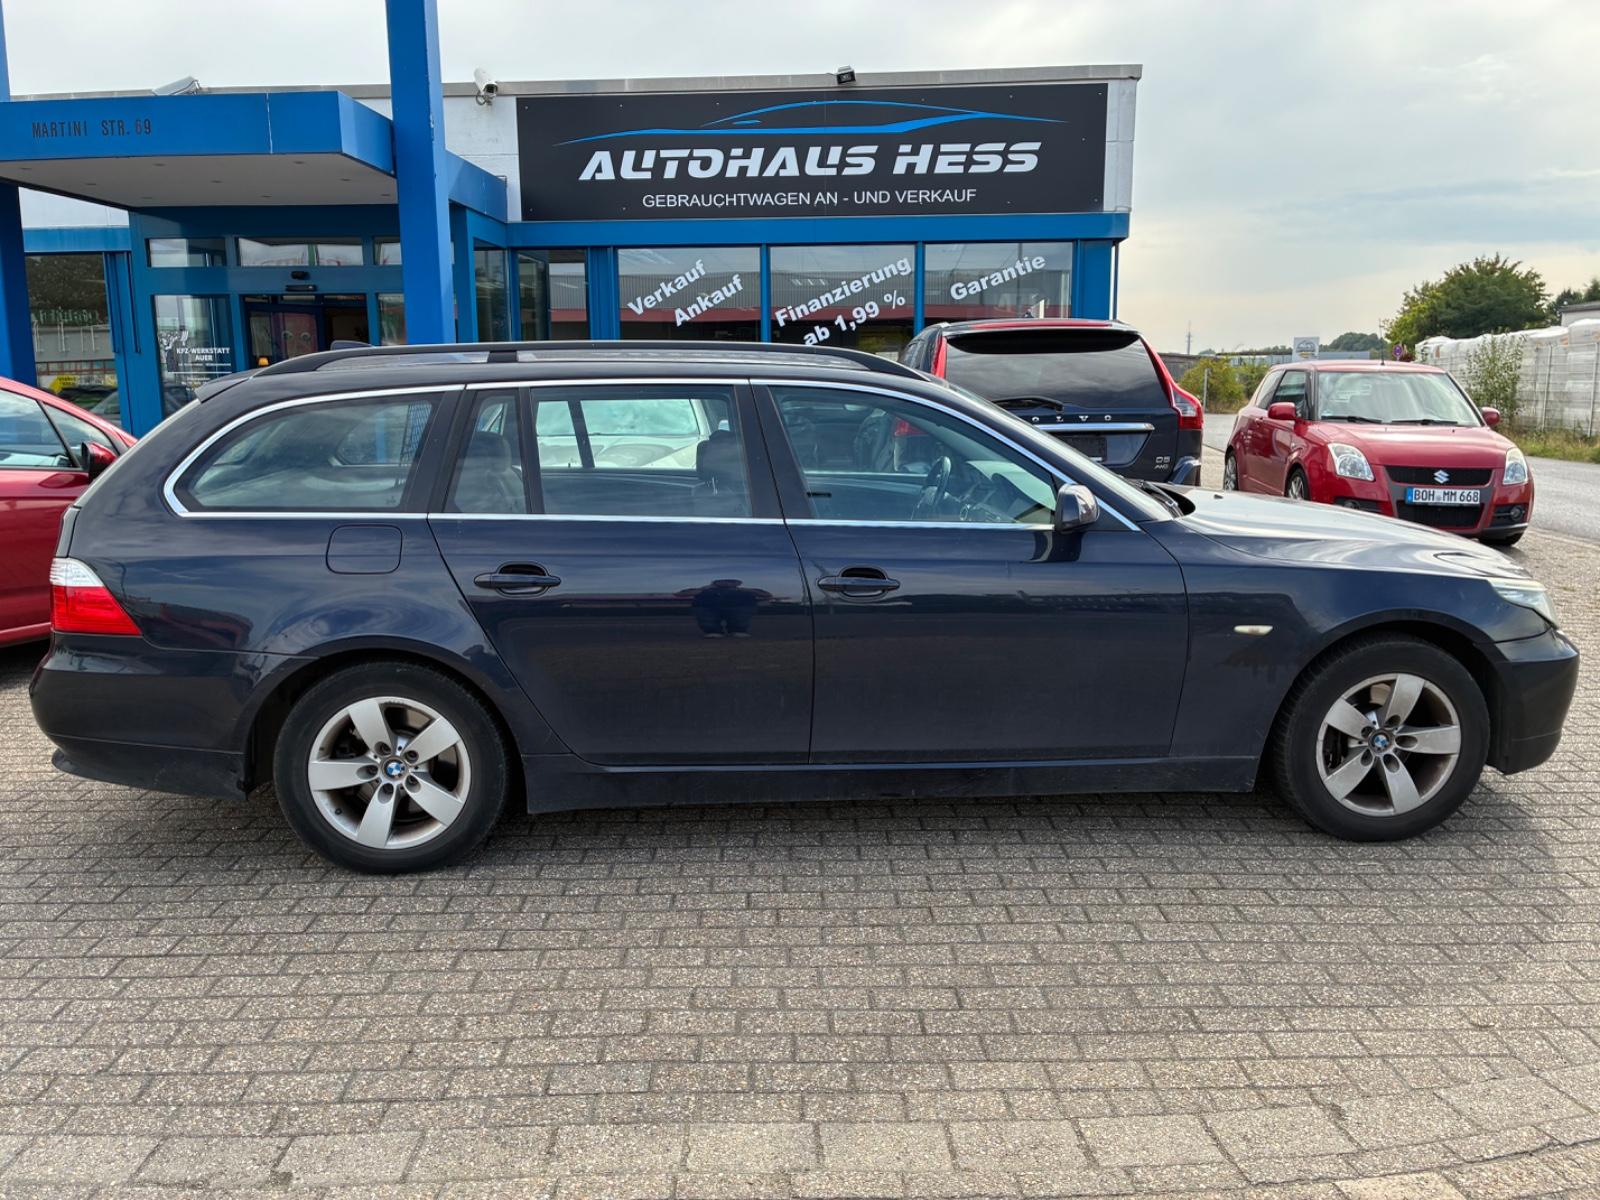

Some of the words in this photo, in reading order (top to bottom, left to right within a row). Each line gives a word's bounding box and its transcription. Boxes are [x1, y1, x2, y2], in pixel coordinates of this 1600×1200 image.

[31, 120, 88, 138] MARTINI
[101, 119, 130, 136] STR.
[135, 118, 151, 135] 69
[578, 145, 879, 181] AUTOHAUS
[892, 141, 1042, 175] HESS
[642, 192, 811, 208] GEBRAUCHTWAGEN
[814, 191, 838, 205] AN
[854, 190, 891, 204] UND
[895, 188, 977, 204] VERKAUF
[627, 259, 706, 316] Verkauf
[775, 257, 912, 327] Finanzierung
[950, 256, 1046, 300] Garantie
[674, 274, 744, 327] Ankauf
[803, 325, 831, 346] ab
[834, 301, 881, 332] 1,99
[883, 290, 906, 309] %
[1031, 414, 1112, 422] OLVO
[1414, 489, 1435, 502] BOH
[1442, 490, 1457, 502] MM
[1460, 491, 1479, 503] 668
